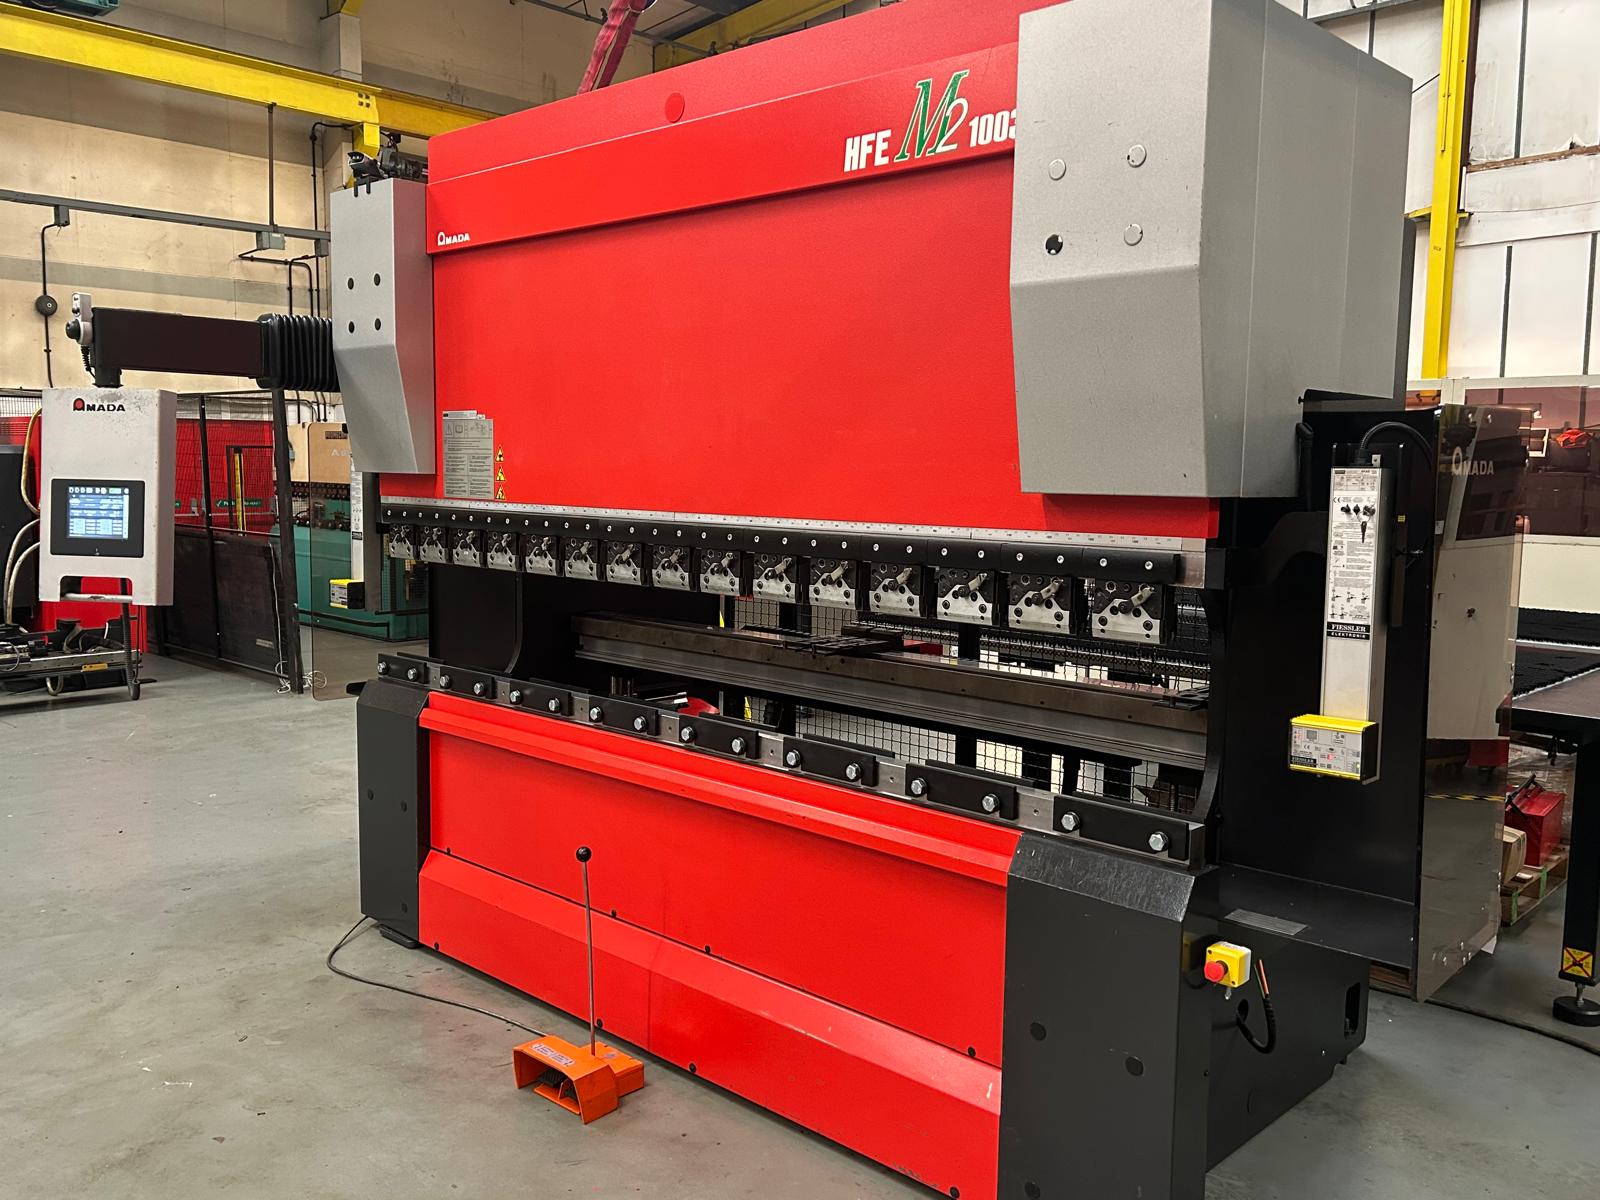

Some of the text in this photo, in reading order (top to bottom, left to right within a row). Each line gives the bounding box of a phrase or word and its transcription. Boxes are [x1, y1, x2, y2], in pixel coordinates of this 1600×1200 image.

[844, 129, 891, 172] HFE
[437, 231, 471, 247] AMADA
[73, 397, 126, 412] AMADA
[1451, 446, 1495, 477] AMADA
[1331, 623, 1366, 633] FIESSLER
